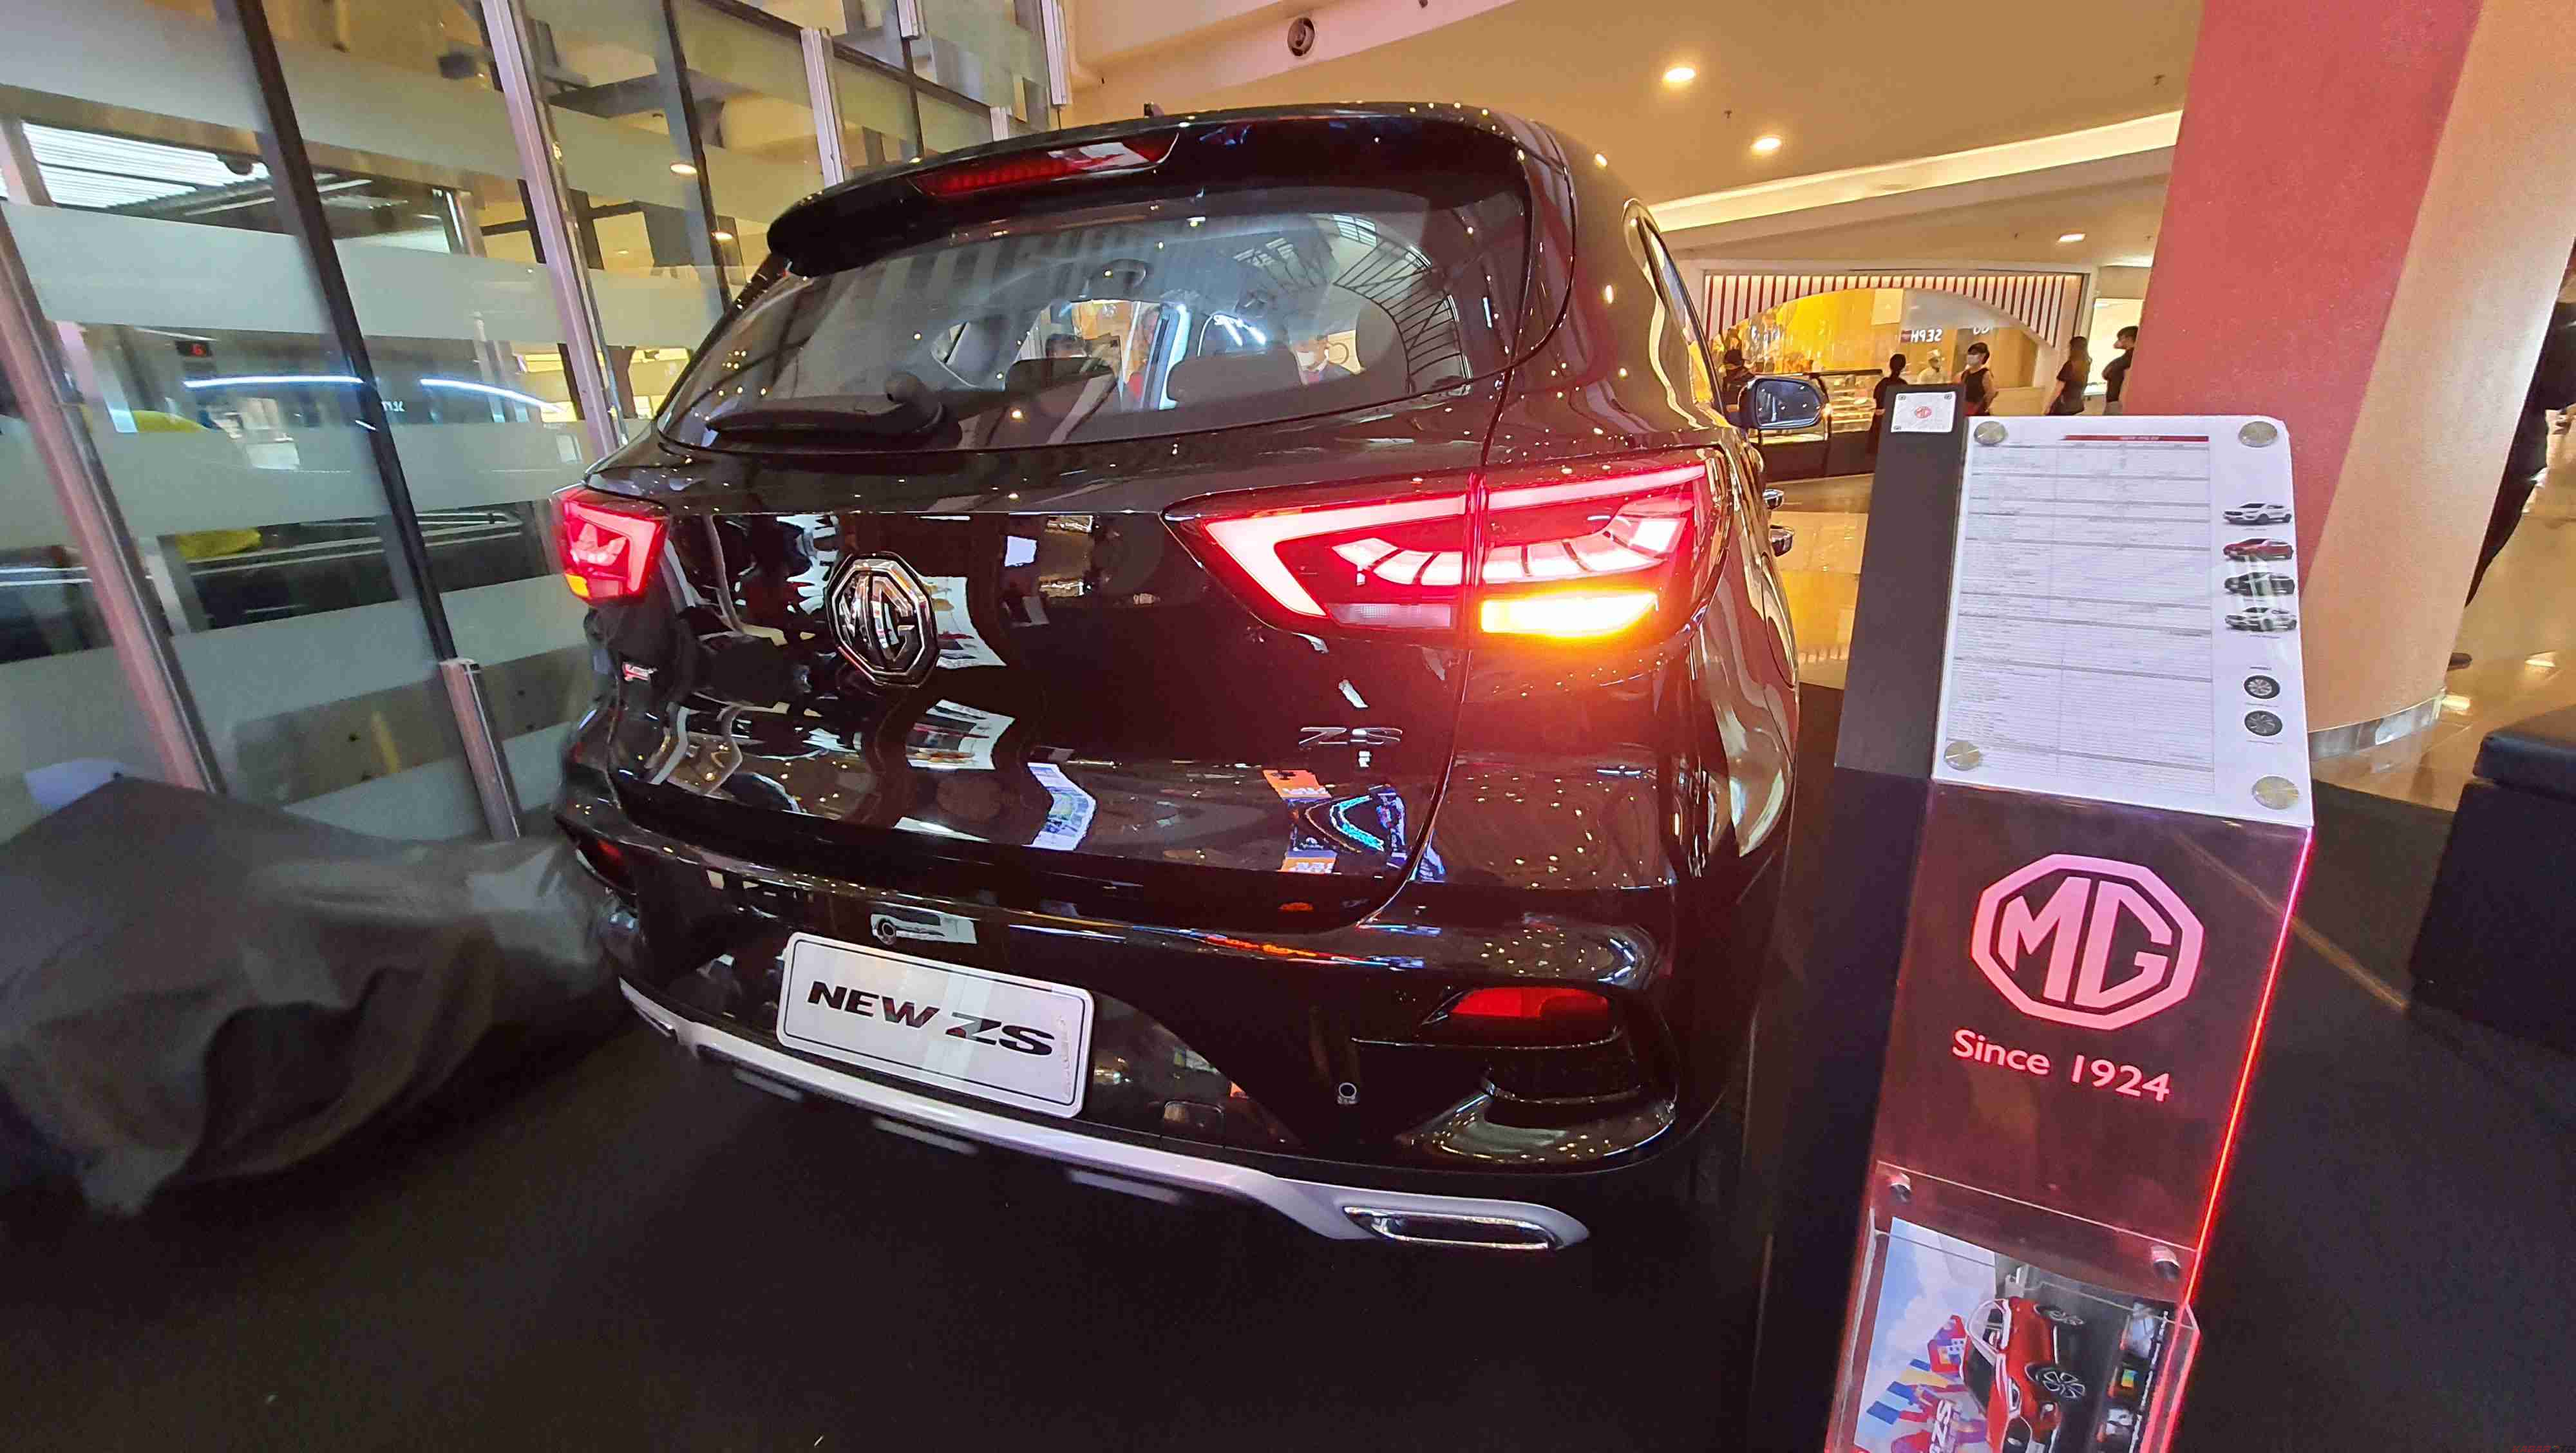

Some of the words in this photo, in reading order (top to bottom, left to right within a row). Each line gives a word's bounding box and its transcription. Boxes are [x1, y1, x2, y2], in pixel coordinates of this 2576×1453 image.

[838, 575, 919, 670] MG
[1298, 726, 1403, 745] ZS
[1997, 876, 2173, 1009] MG
[806, 980, 940, 1029] NEW
[945, 1011, 1056, 1056] ZS
[1952, 1029, 2050, 1076] Since
[2070, 1054, 2171, 1102] 1924
